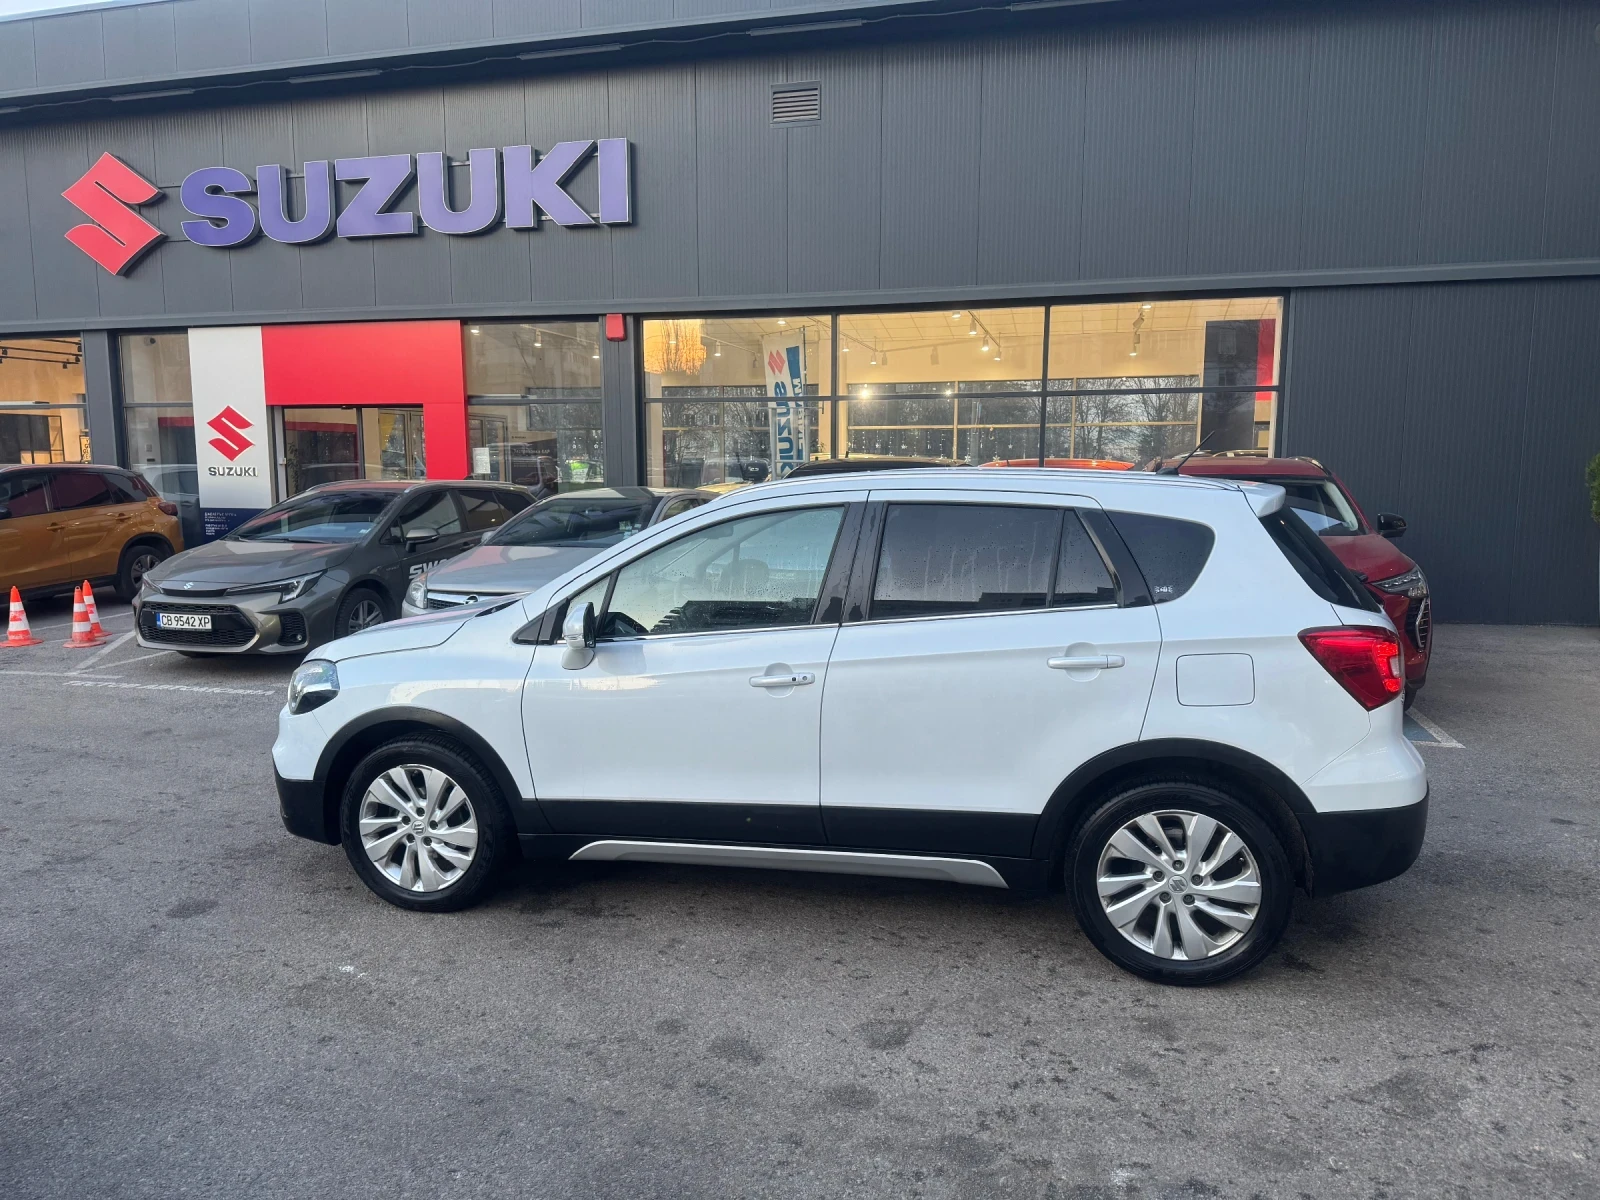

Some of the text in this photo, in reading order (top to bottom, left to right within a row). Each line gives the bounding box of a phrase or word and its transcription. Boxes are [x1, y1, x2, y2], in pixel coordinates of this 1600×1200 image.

[180, 137, 632, 247] SUZUKI
[208, 466, 257, 477] SUZUKI
[409, 559, 448, 580] SW
[174, 616, 196, 627] 9542
[198, 617, 210, 628] XP
